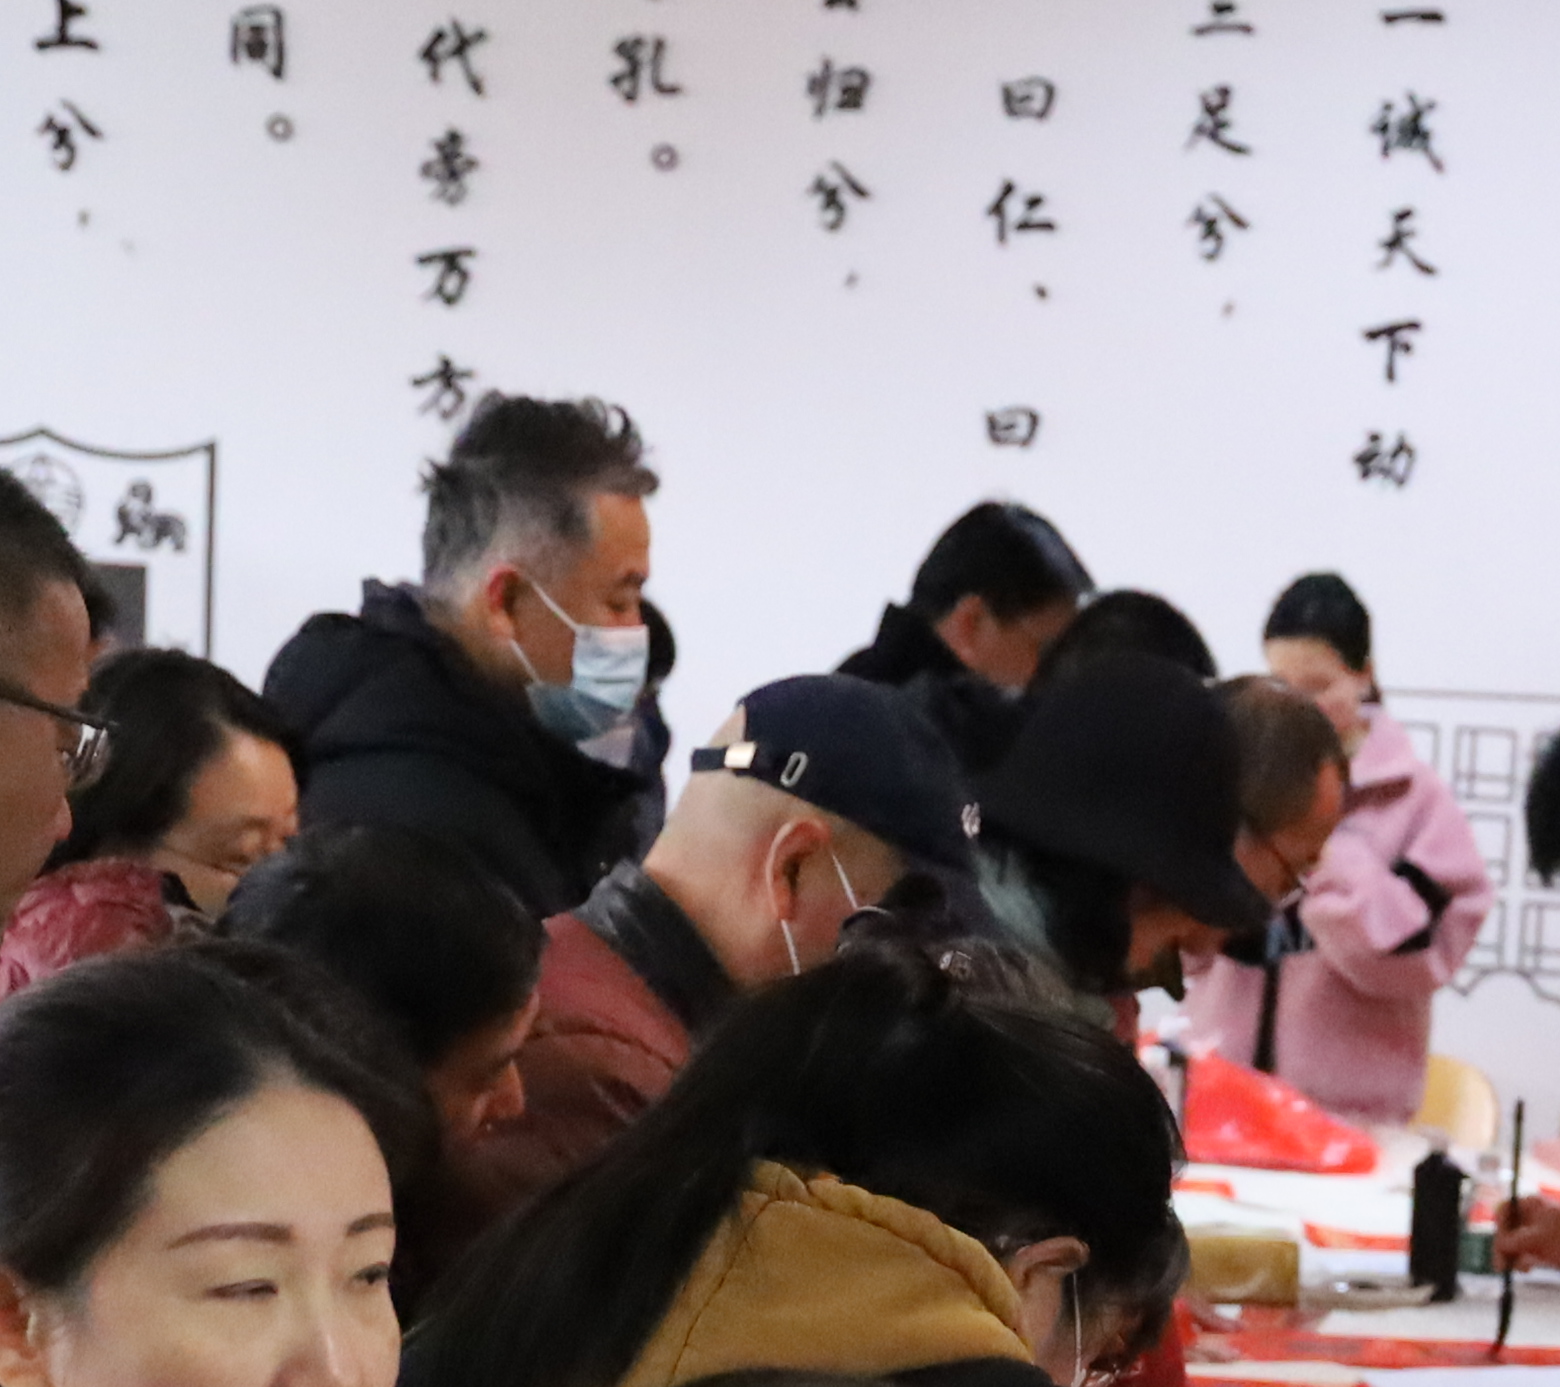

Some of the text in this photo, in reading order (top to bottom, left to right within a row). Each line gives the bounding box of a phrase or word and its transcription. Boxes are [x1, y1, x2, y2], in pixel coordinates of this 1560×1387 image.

[412, 20, 486, 494] 代旁万方
[806, 0, 870, 288] 归兮，
[1352, 10, 1446, 490] 一诚天下动
